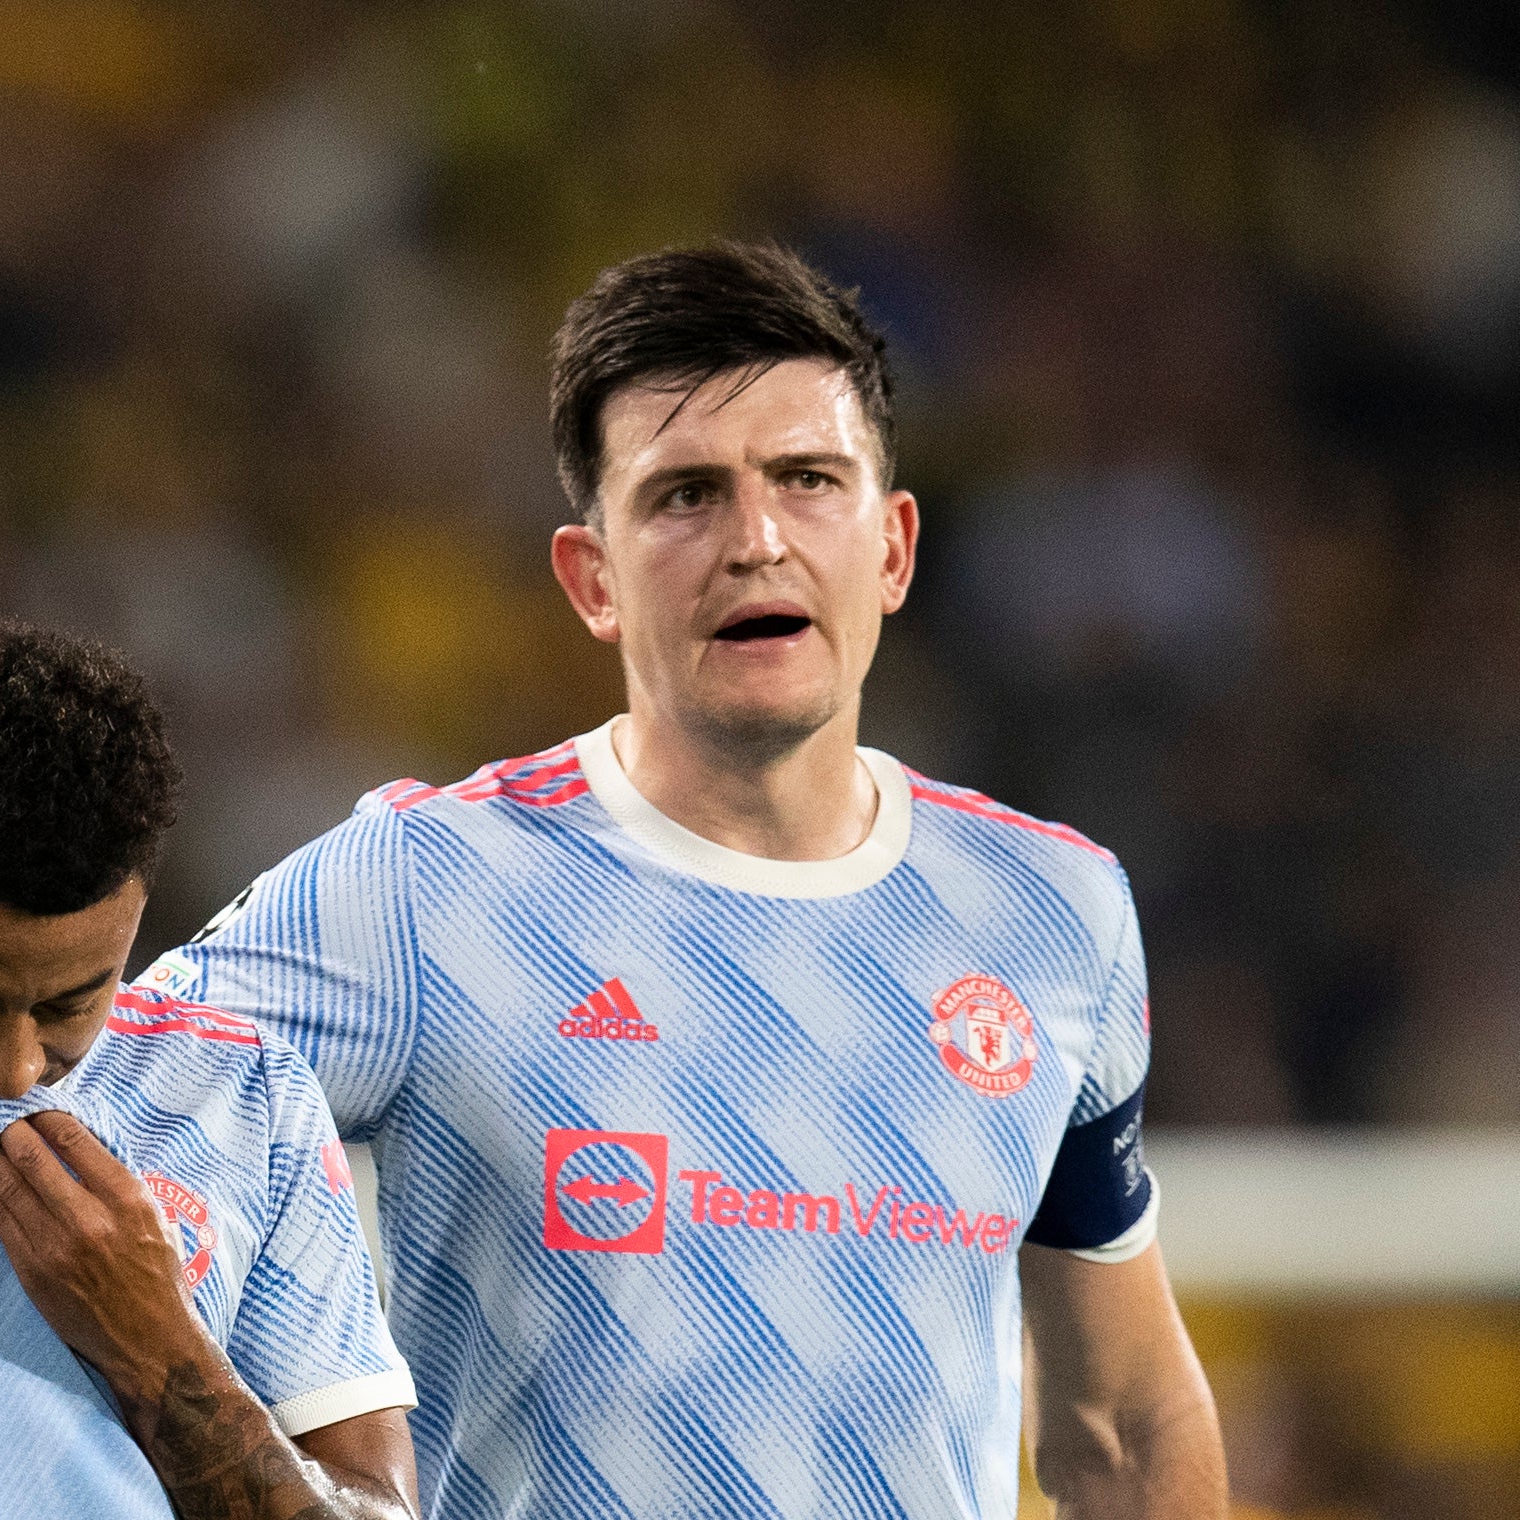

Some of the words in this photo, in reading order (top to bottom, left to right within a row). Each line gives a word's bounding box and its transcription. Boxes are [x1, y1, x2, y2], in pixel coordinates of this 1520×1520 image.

[558, 1014, 660, 1042] adidas
[959, 1063, 1021, 1089] UNITED
[678, 1168, 1020, 1254] TeamViewer
